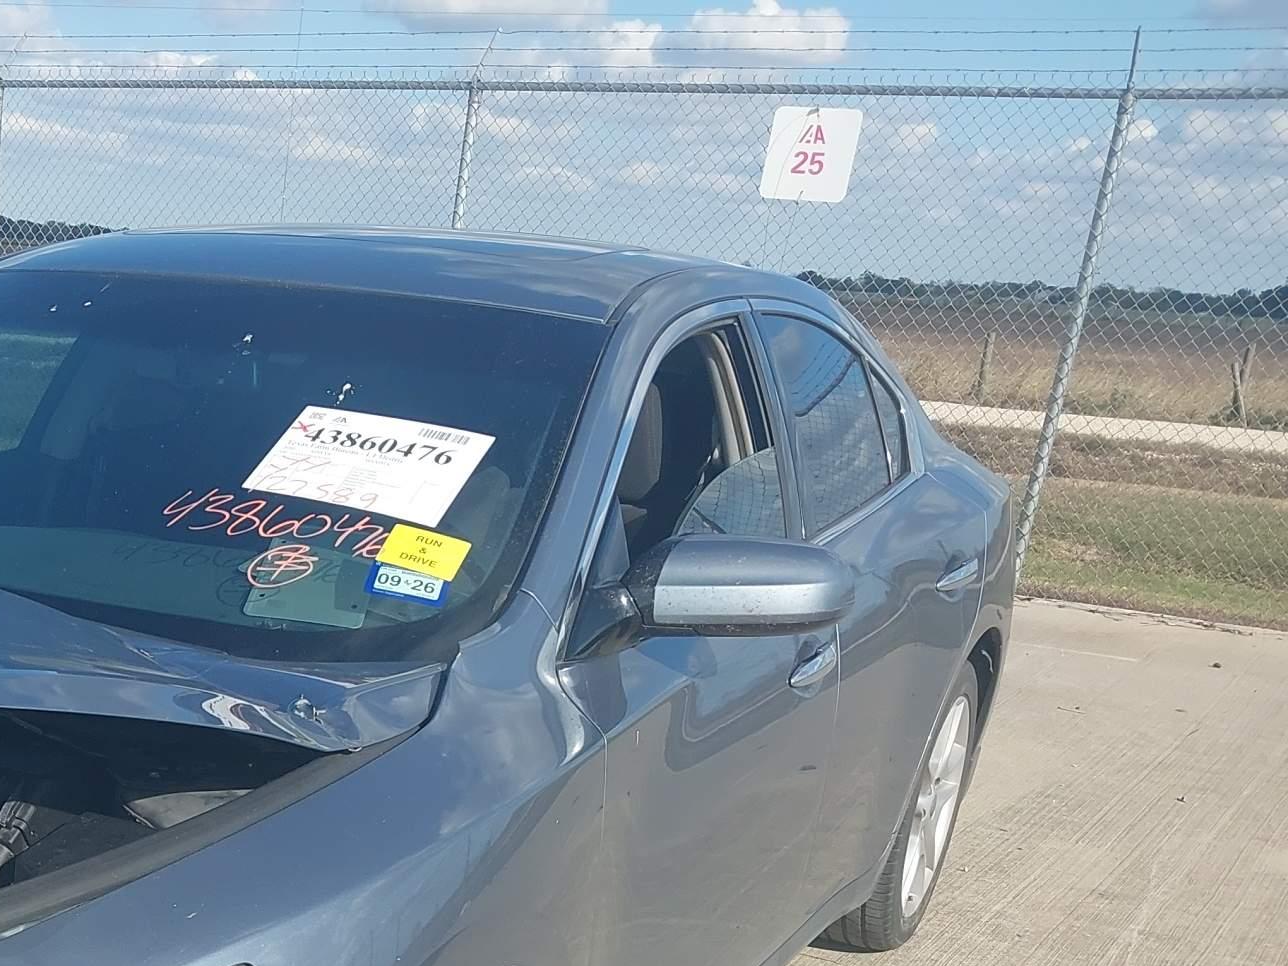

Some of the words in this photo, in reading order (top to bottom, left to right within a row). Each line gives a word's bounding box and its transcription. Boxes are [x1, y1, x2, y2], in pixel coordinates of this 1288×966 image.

[790, 151, 825, 175] 25
[304, 427, 458, 466] 43860476
[415, 535, 443, 548] RUN
[418, 547, 428, 555] &
[399, 552, 438, 569] DRIVE
[377, 573, 402, 587] 09
[410, 579, 436, 594] 26
